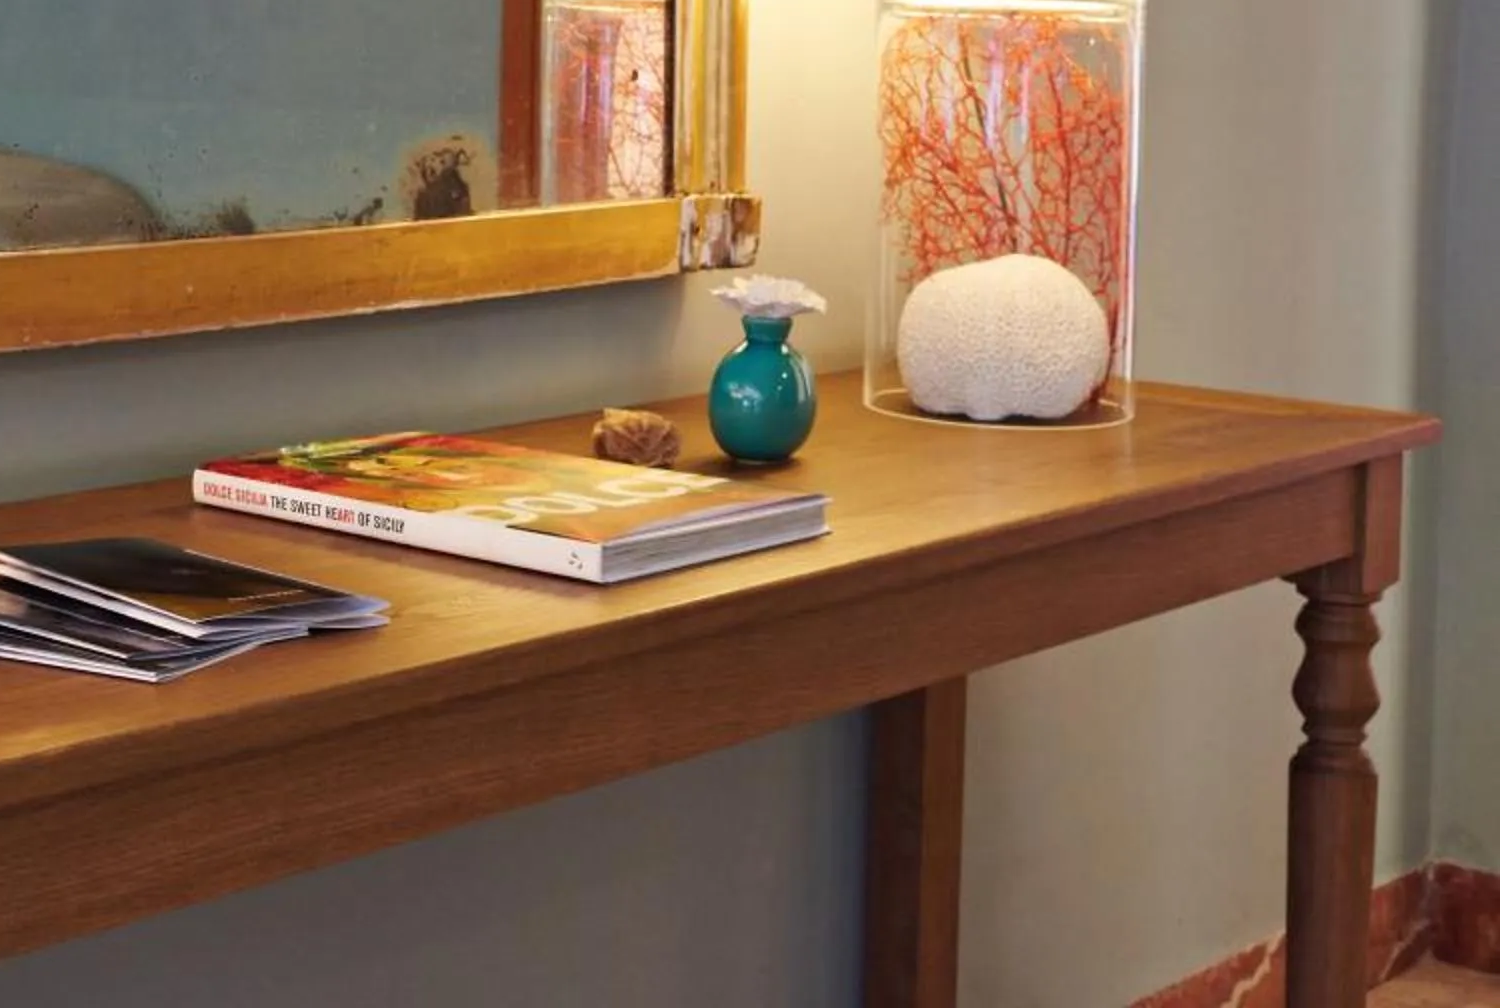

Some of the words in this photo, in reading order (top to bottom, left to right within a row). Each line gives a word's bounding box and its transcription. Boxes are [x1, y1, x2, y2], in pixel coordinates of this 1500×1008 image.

[203, 482, 234, 500] DOLCE
[235, 488, 268, 507] SICILIA
[271, 495, 288, 511] THE
[290, 499, 321, 518] SWEET
[325, 505, 355, 524] HEART
[357, 512, 371, 527] OF
[374, 515, 405, 534] SICILY
